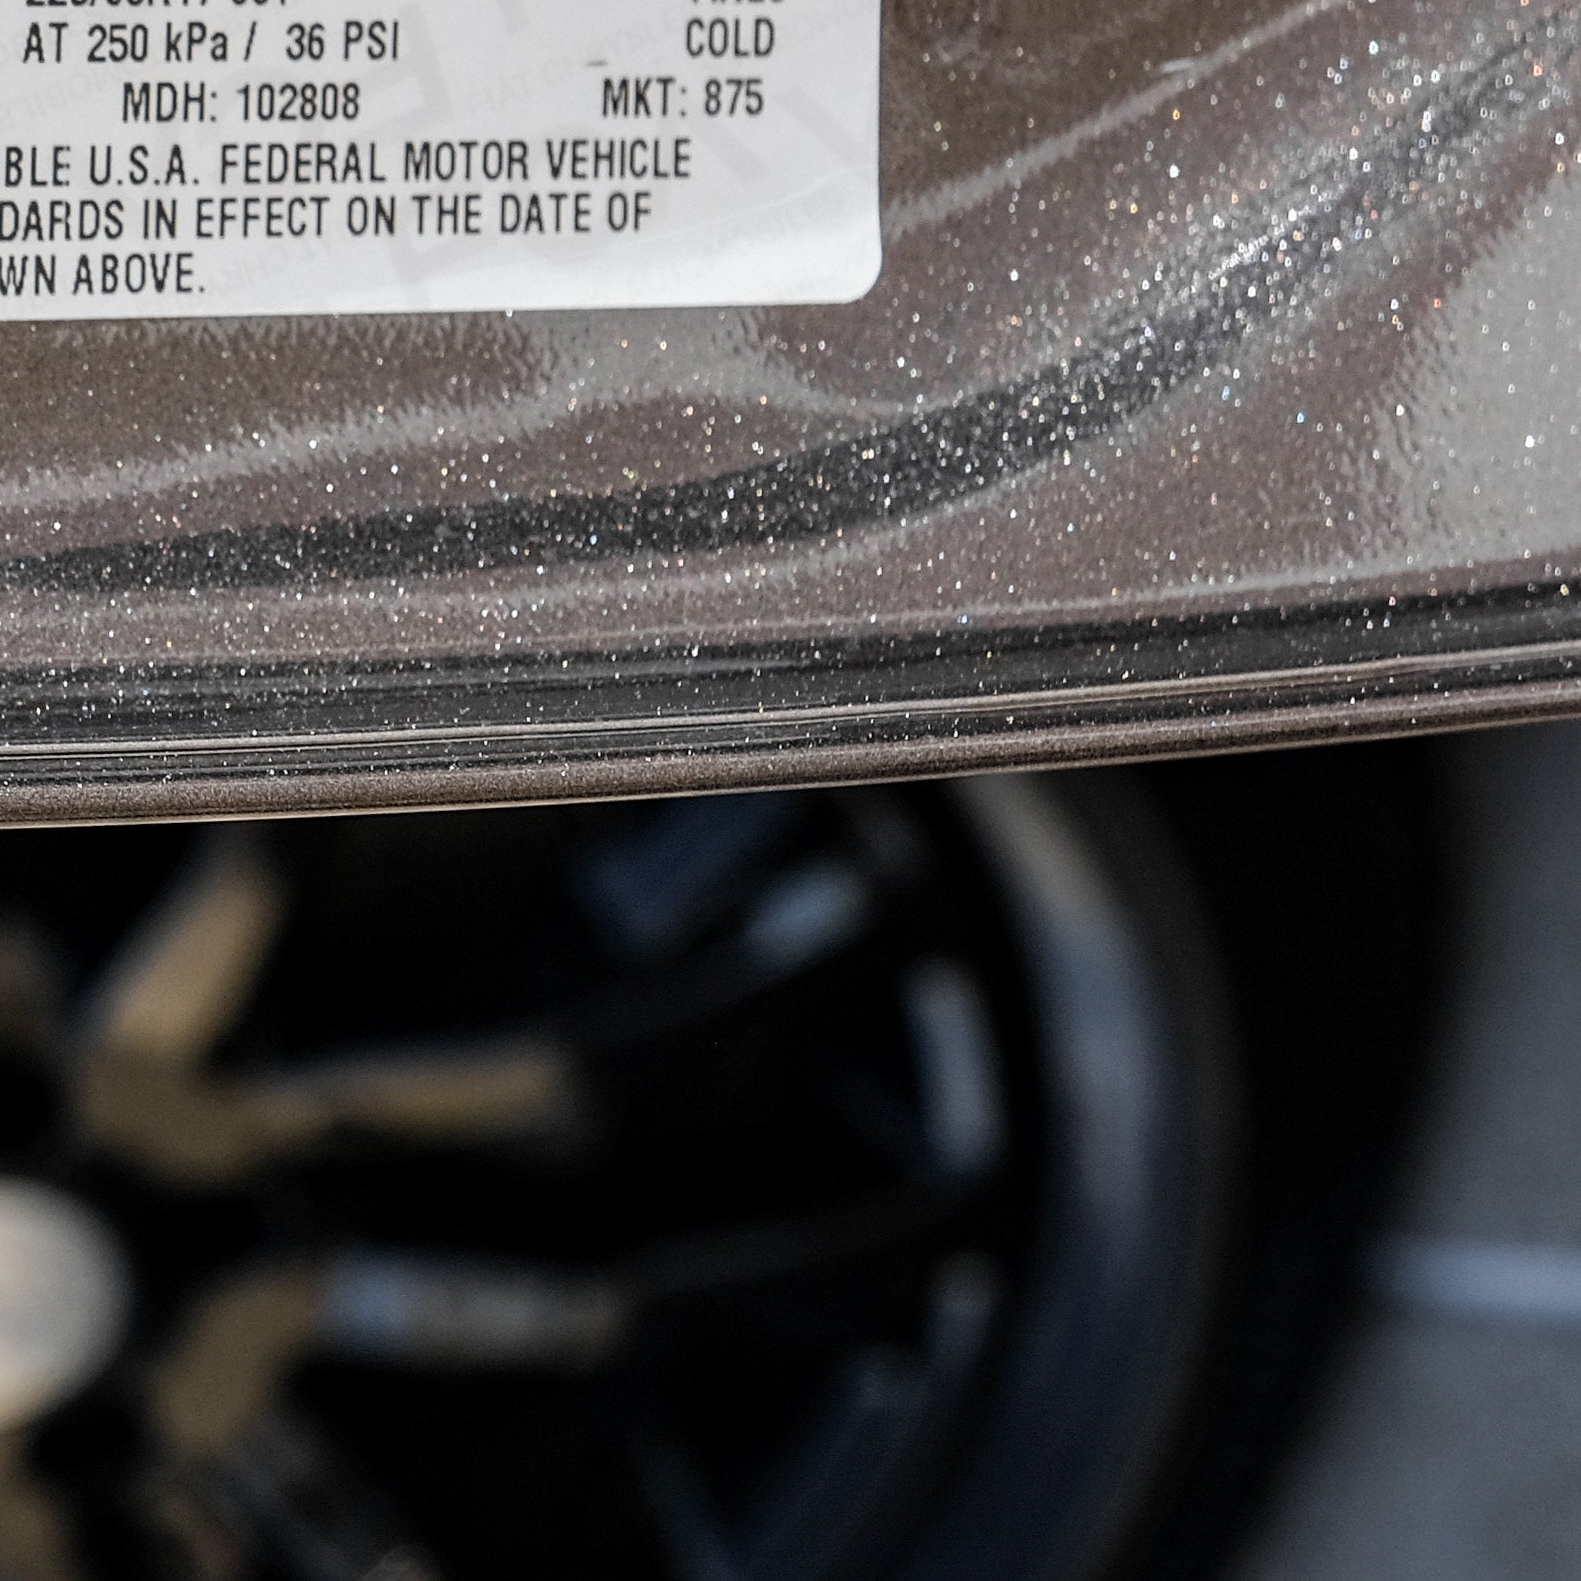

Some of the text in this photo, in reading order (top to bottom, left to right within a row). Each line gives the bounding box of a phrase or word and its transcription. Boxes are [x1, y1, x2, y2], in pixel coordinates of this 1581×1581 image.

[23, 23, 68, 63] AT
[88, 24, 148, 62] 250
[166, 22, 227, 61] kPa
[287, 23, 324, 60] 36
[345, 21, 398, 59] PSI
[687, 18, 774, 57] COLD
[123, 83, 359, 122] MDH: 102808
[602, 77, 763, 117] MKT: 875
[90, 145, 198, 185] U.S.A.
[221, 143, 385, 184] FEDERAL
[405, 141, 528, 180] MOTOR
[547, 139, 689, 179] VEHICLE
[144, 199, 176, 239] IN
[197, 197, 329, 238] EFFECT
[348, 197, 395, 235] ON
[412, 195, 480, 234] THE
[501, 193, 590, 233] DATE
[608, 192, 649, 231] OF
[72, 254, 205, 296] ABOVE.
